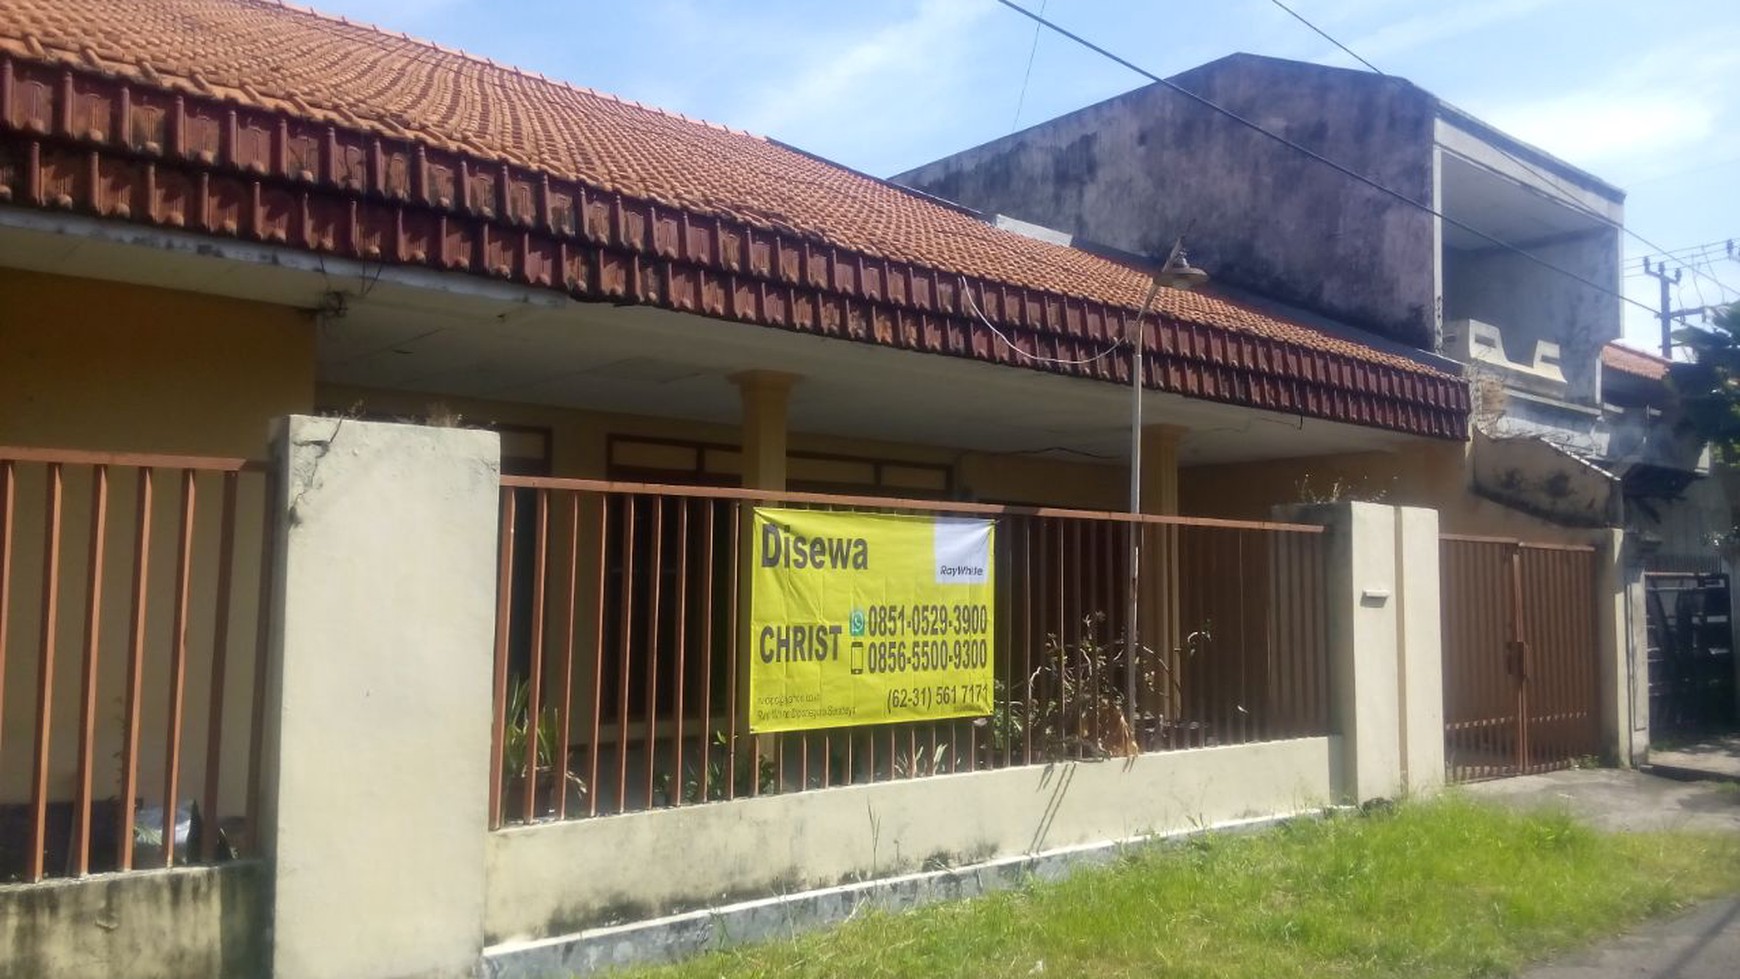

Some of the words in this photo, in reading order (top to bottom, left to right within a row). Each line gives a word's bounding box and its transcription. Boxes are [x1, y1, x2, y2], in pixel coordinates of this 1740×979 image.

[762, 524, 868, 569] Disewa
[868, 604, 987, 637] 0851-0529-3900
[760, 625, 842, 664] CHRIST
[868, 639, 987, 674] 0856-5500-9300
[887, 688, 932, 713] (62-31)
[936, 685, 957, 704] 561
[961, 683, 989, 703] 7171
